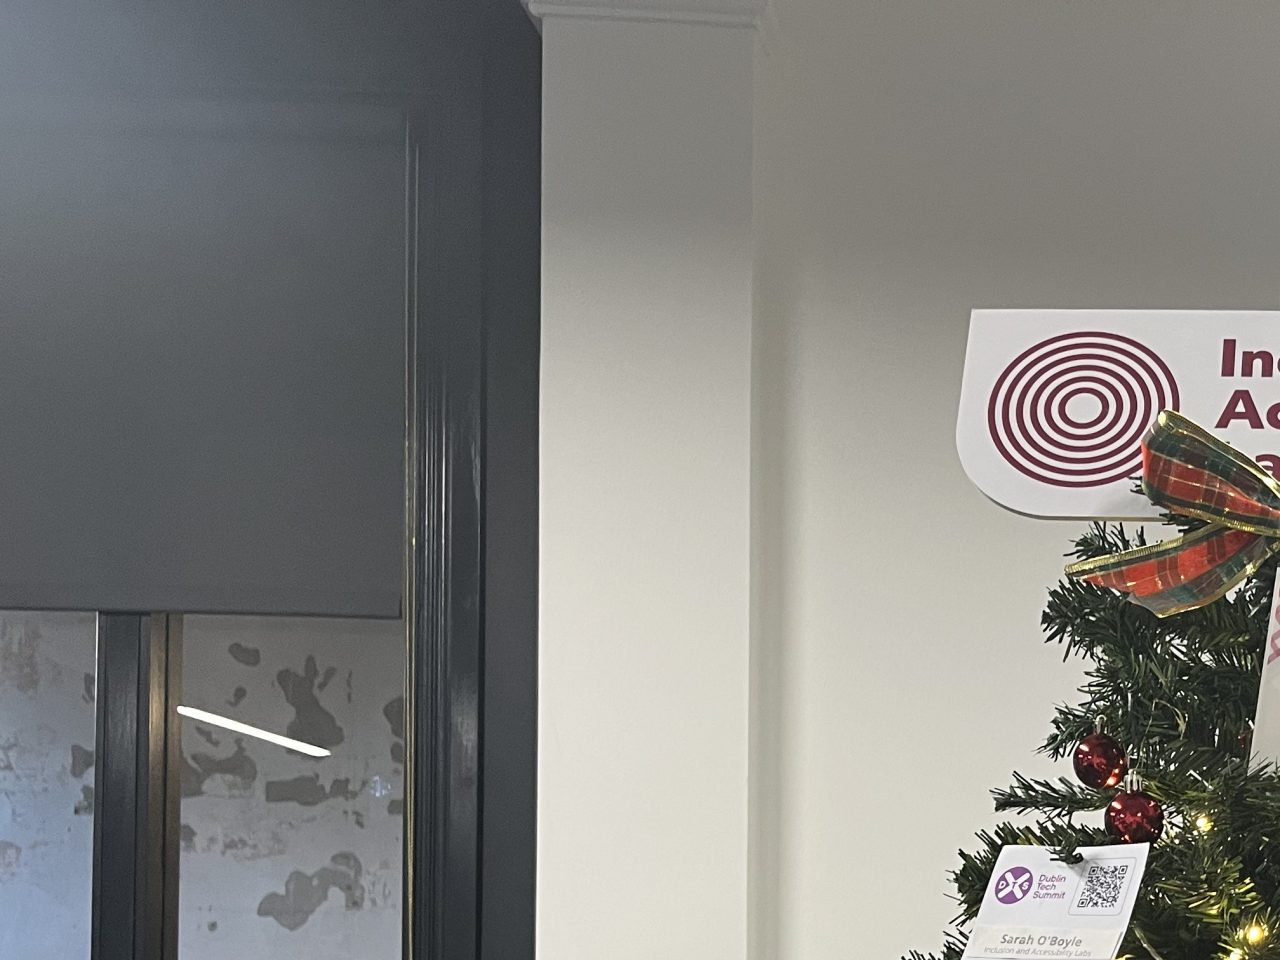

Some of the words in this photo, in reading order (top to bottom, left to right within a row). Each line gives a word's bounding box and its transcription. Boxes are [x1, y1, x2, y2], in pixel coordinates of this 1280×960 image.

[1039, 874, 1066, 883] Dublin
[1036, 882, 1056, 891] Tech
[1033, 891, 1065, 899] Summit
[1000, 934, 1034, 945] Sarah
[1037, 936, 1082, 949] O'Boyle
[984, 946, 1014, 954] Inclusion
[1015, 947, 1030, 955] and
[1031, 948, 1072, 957] Accessibility
[1074, 949, 1092, 957] Labs
